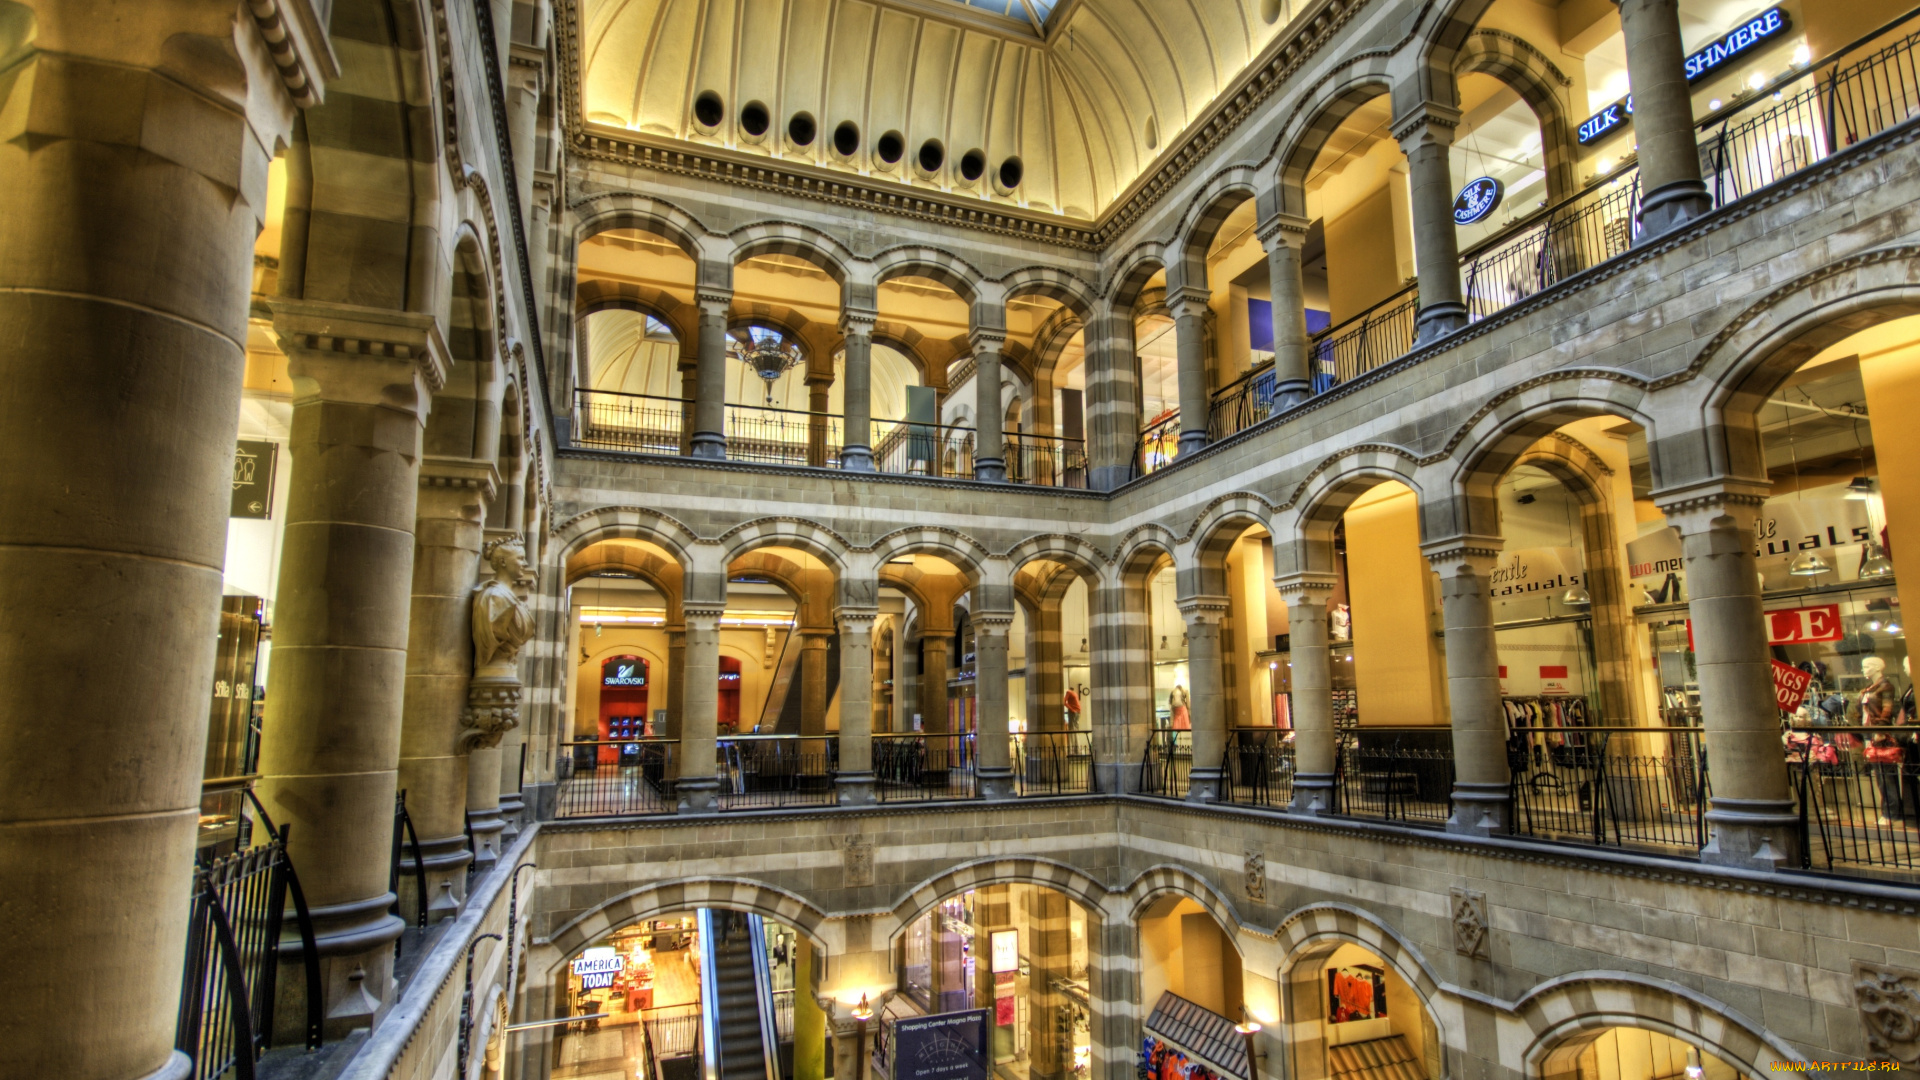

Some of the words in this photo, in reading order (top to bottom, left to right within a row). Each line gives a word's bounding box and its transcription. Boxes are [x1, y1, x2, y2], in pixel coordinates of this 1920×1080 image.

[1578, 106, 1620, 144] SILK
[1684, 8, 1782, 80] SHMERE
[1463, 182, 1482, 202] SILK
[1467, 193, 1479, 209] &
[1454, 188, 1494, 220] CASHMERE
[1489, 554, 1529, 585] entle
[1764, 607, 1837, 643] LE
[604, 677, 645, 686] SWAROVSKI
[576, 957, 621, 973] AMERICA
[582, 971, 614, 989] TODAY
[901, 1023, 928, 1032] Shopping
[928, 1019, 946, 1028] Center
[946, 1016, 966, 1026] Magna
[966, 1014, 982, 1022] Plaza
[955, 1062, 968, 1070] week
